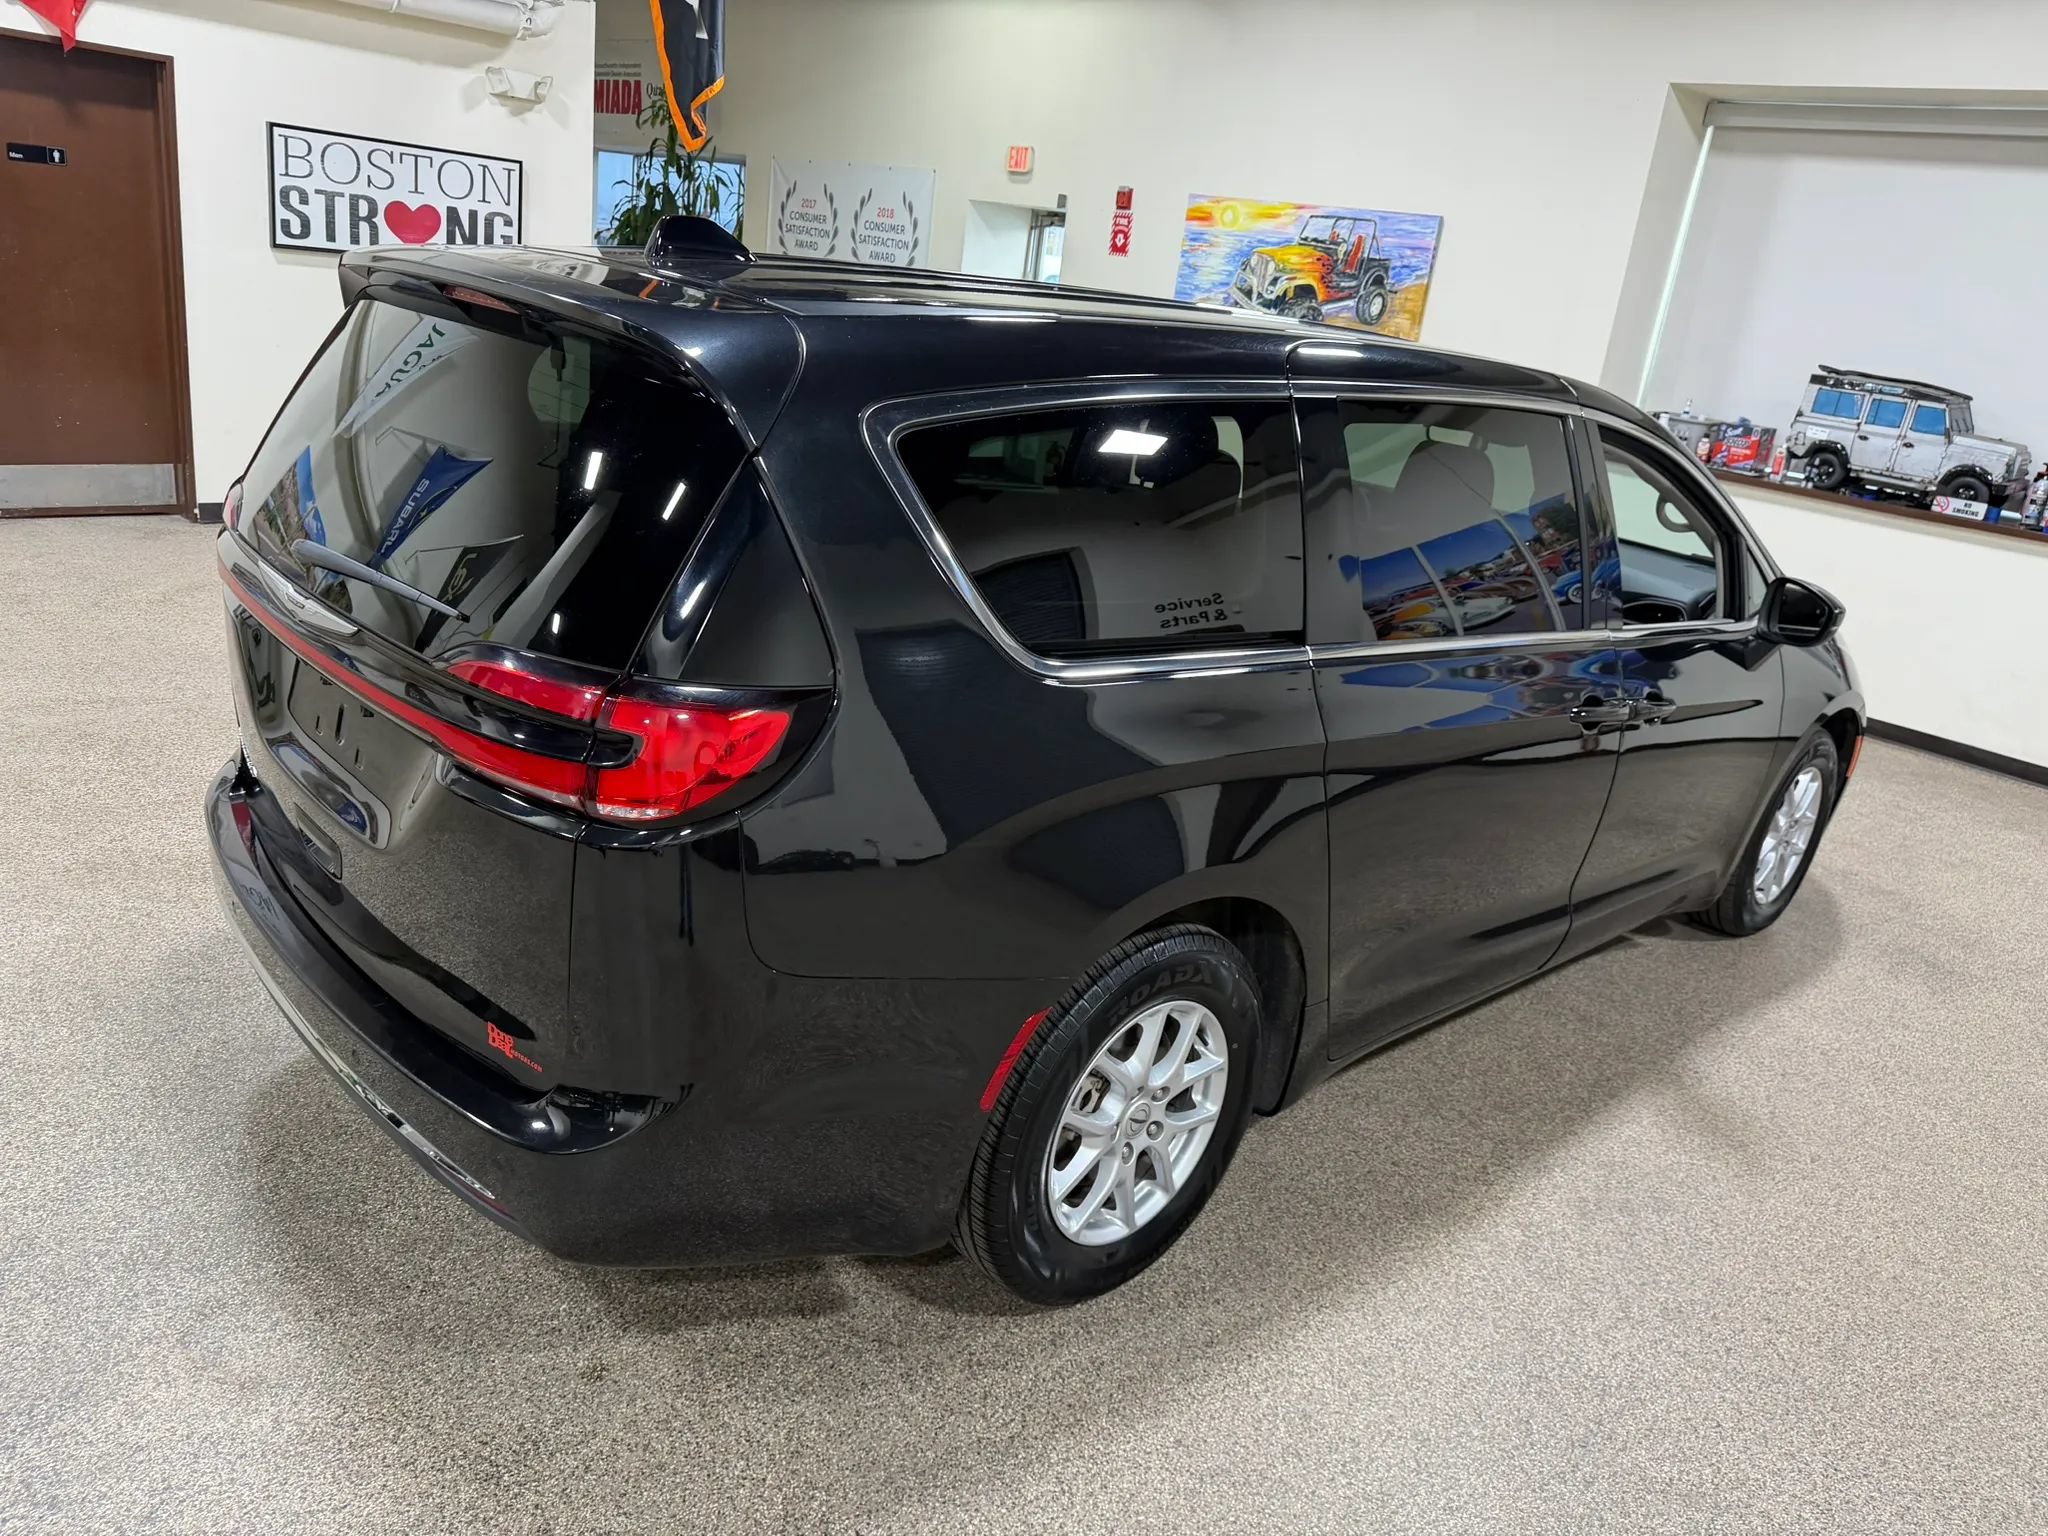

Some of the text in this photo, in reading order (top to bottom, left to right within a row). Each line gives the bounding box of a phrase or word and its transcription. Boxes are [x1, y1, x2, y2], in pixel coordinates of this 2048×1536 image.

[9, 151, 24, 159] Men
[1008, 146, 1029, 169] EXIT
[278, 133, 516, 207] BOSTON
[801, 198, 817, 209] 2017
[279, 185, 514, 246] STRNG
[789, 210, 827, 225] CONSUMER
[877, 207, 895, 219] 2018
[785, 223, 830, 240] SATISFACTION
[863, 220, 906, 236] CONSUMER
[794, 239, 819, 251] AWARD
[858, 233, 909, 251] SATISFACTION
[868, 250, 896, 264] AWARD
[374, 322, 446, 399] JAGUA
[1951, 507, 1980, 518] SMOKING
